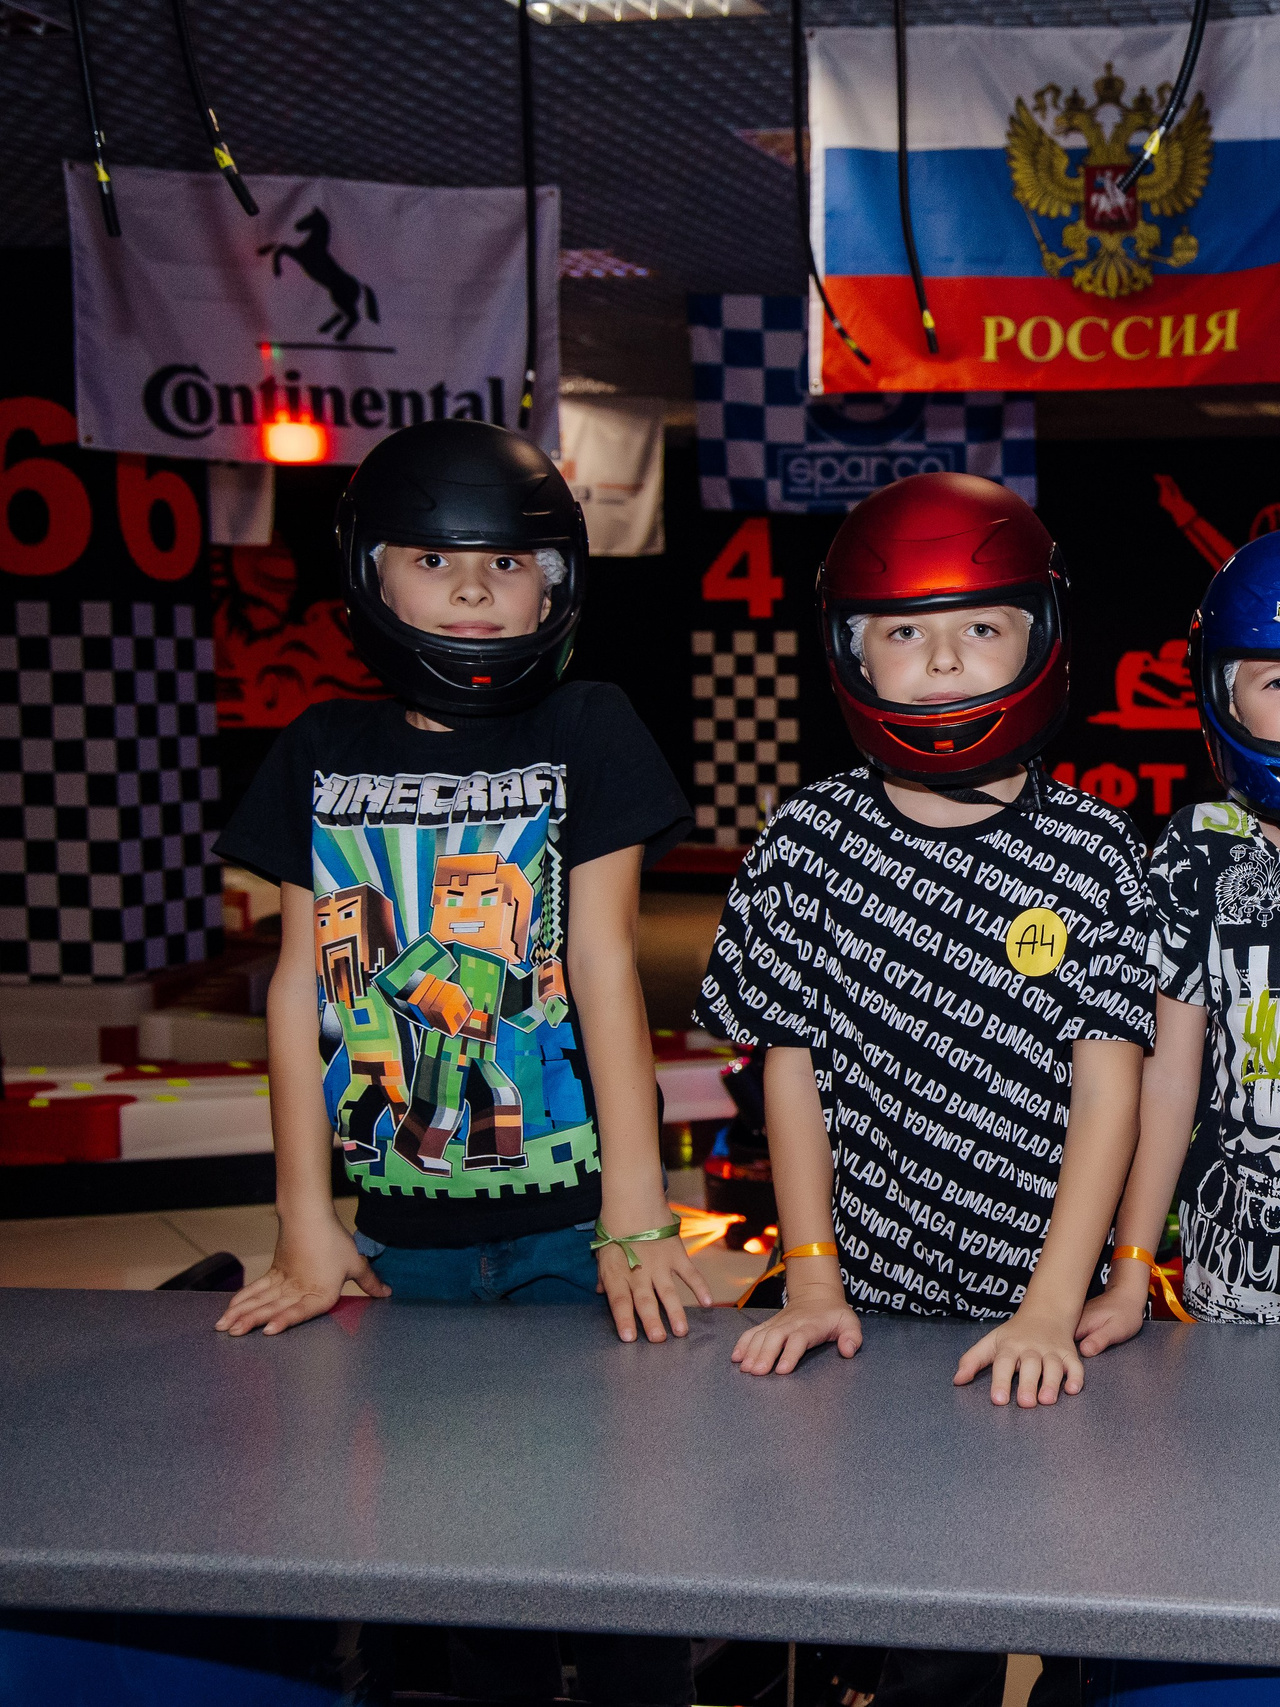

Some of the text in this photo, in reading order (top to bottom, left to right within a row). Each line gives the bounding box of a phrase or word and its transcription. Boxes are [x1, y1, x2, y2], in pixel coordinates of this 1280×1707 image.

[981, 309, 1241, 362] РОССИЯ
[143, 363, 504, 439] Continental
[787, 455, 946, 496] sparco
[703, 518, 784, 619] 4
[313, 762, 567, 826] MINECRAFT
[838, 829, 917, 891] BUMAGA
[860, 892, 944, 957] BUMAGA
[912, 878, 963, 918] VLAD
[1014, 923, 1056, 958] A4
[884, 961, 933, 1003] VLAD
[943, 938, 1027, 999] BUMAGA
[859, 985, 929, 1042] BUMAGA
[933, 986, 985, 1028] VLAD
[981, 1013, 1053, 1074] BUMAGA
[1022, 986, 1063, 1025] VLAD
[862, 1042, 901, 1080] VLAD
[903, 1067, 948, 1104] VLAD
[948, 1047, 993, 1083] VLAD
[844, 1061, 903, 1122] BUMAGA
[987, 1071, 1052, 1121] BUMAGA
[902, 1106, 976, 1161] BUMAGA
[900, 1155, 943, 1191] VLAD
[972, 1148, 1015, 1182] VLAD
[843, 1147, 956, 1242] VLAD BUMAGA
[840, 1186, 955, 1275] VLAD BUMAGA
[841, 1268, 906, 1310] BUMAG
[870, 1252, 952, 1305] BUMAGA
[958, 1268, 1009, 1297] VLAD
